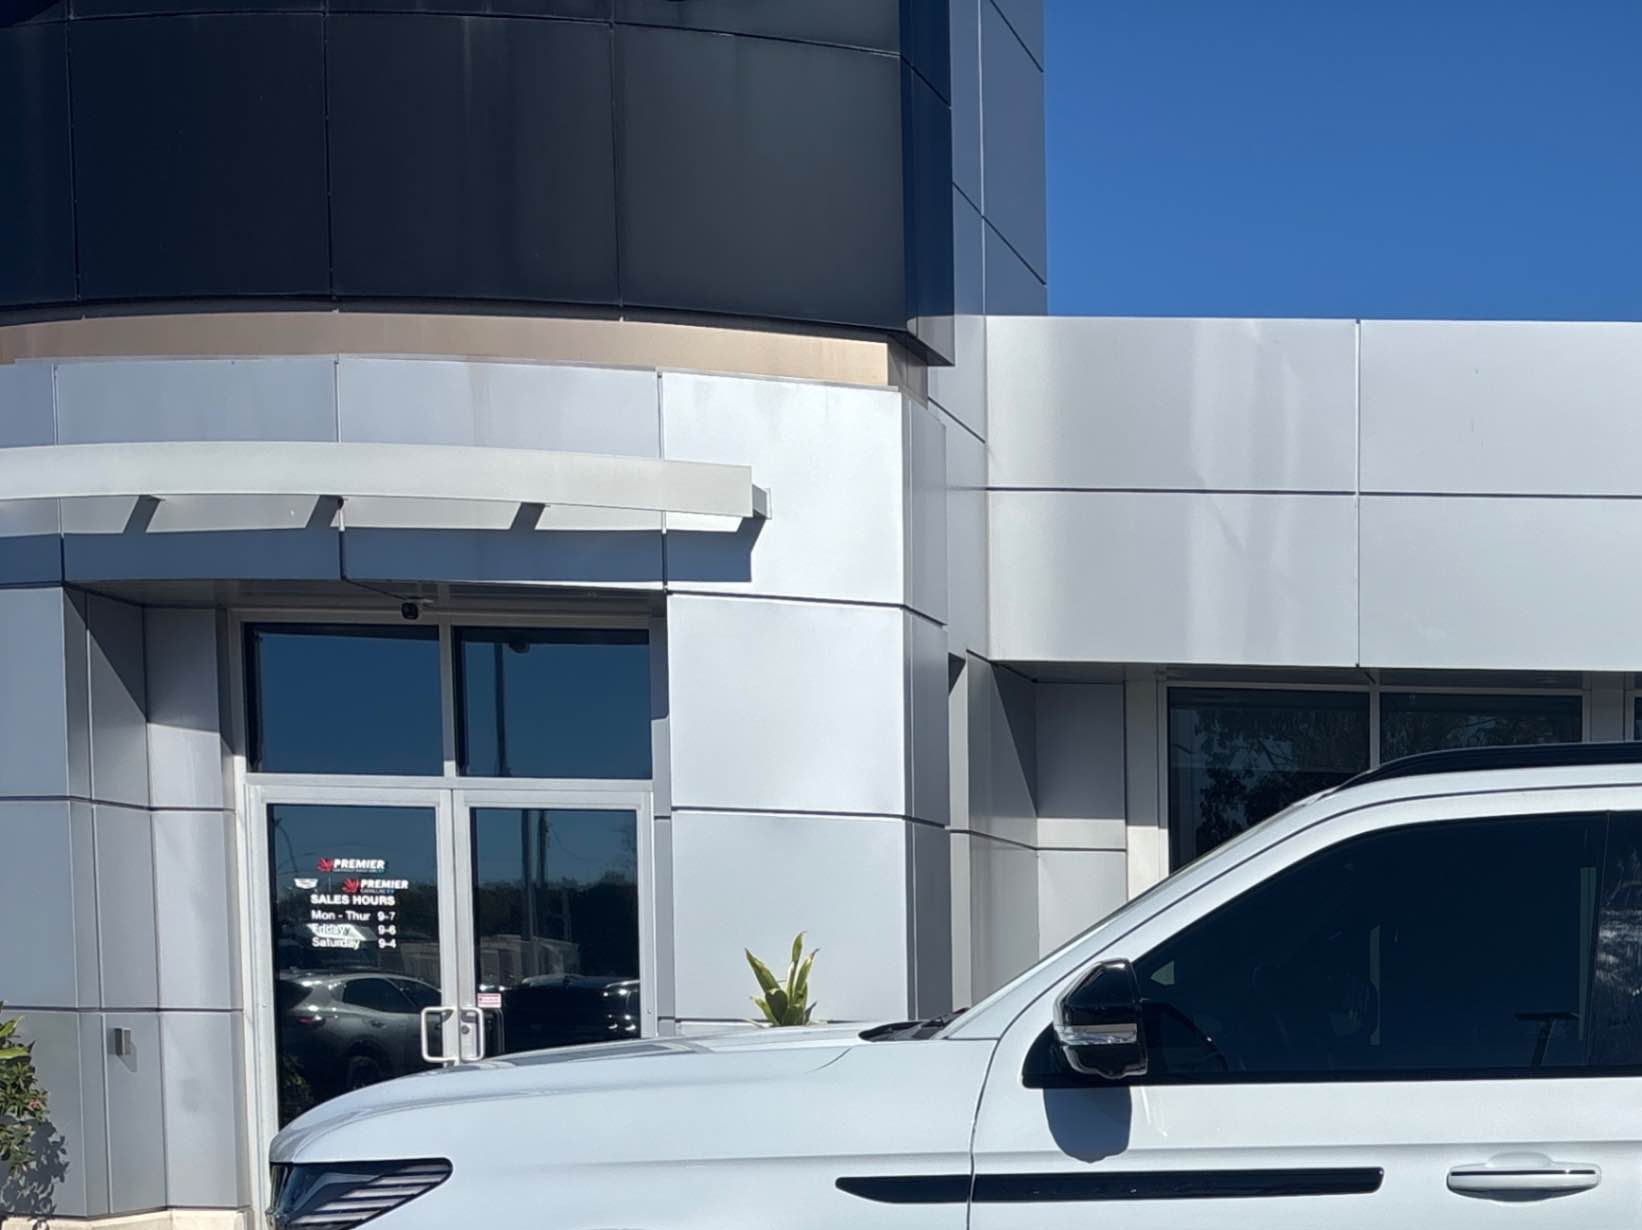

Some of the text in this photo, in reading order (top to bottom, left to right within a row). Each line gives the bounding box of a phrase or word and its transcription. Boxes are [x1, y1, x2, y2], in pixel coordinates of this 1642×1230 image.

[333, 858, 386, 869] PREMIER
[360, 879, 409, 889] PREMIER
[310, 894, 396, 906] SALES HOURS
[310, 909, 336, 920] Mon
[345, 910, 371, 921] Thur
[377, 911, 396, 922] 9-7
[311, 937, 397, 950] Saturday 9-4
